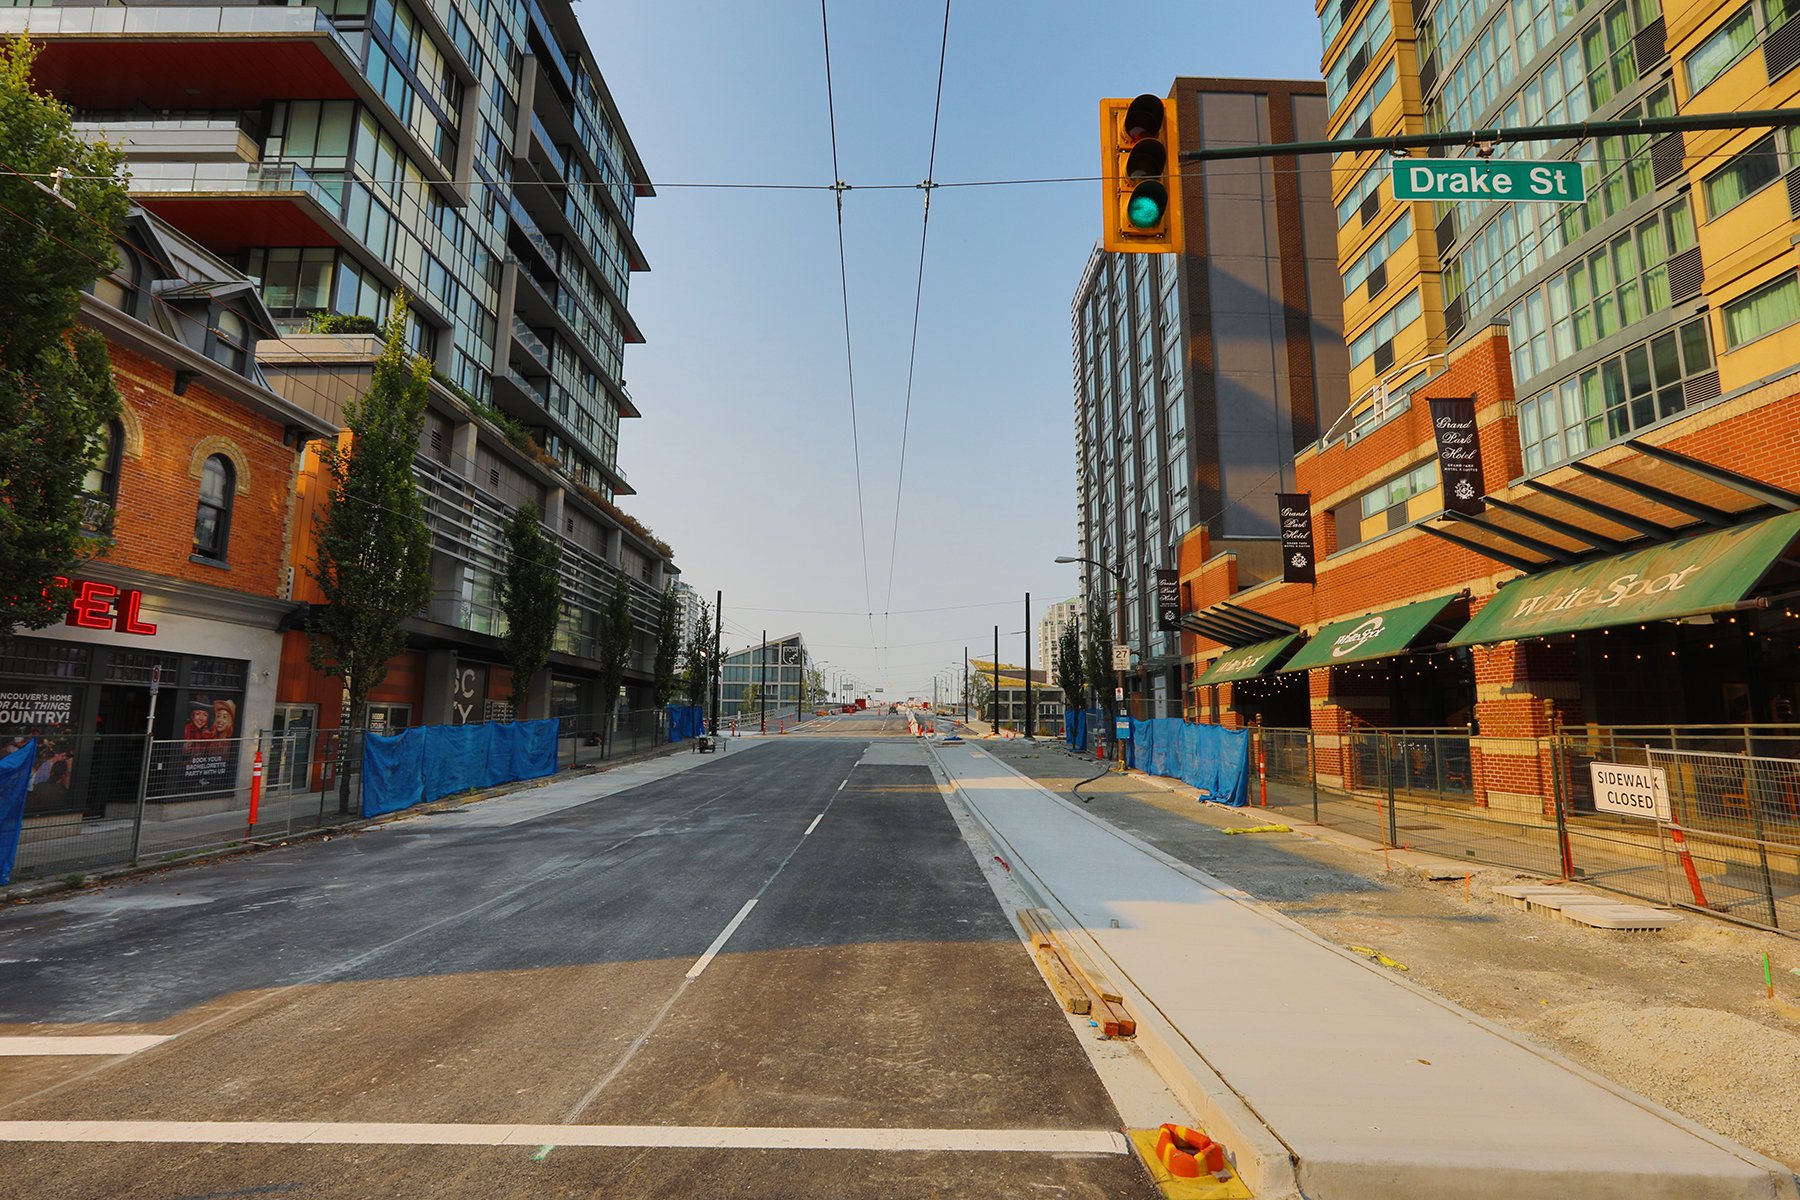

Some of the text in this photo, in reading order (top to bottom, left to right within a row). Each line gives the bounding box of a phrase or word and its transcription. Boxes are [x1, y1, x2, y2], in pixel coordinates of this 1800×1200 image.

[1410, 166, 1568, 195] Drake St
[1436, 416, 1473, 429] Grand
[1441, 431, 1473, 444] Park
[1441, 446, 1477, 460] Hotel
[1280, 507, 1308, 517] Grand
[1283, 518, 1308, 528] Park
[1282, 530, 1310, 539] Hotel
[1512, 564, 1702, 618] White Spot
[52, 575, 157, 636] EL
[1115, 650, 1128, 658] 27
[49, 694, 73, 702] HOME
[10, 701, 31, 710] ALL
[34, 702, 71, 711] THINGS
[1597, 771, 1660, 791] SIDEWALK
[1607, 791, 1653, 809] CLOSED
